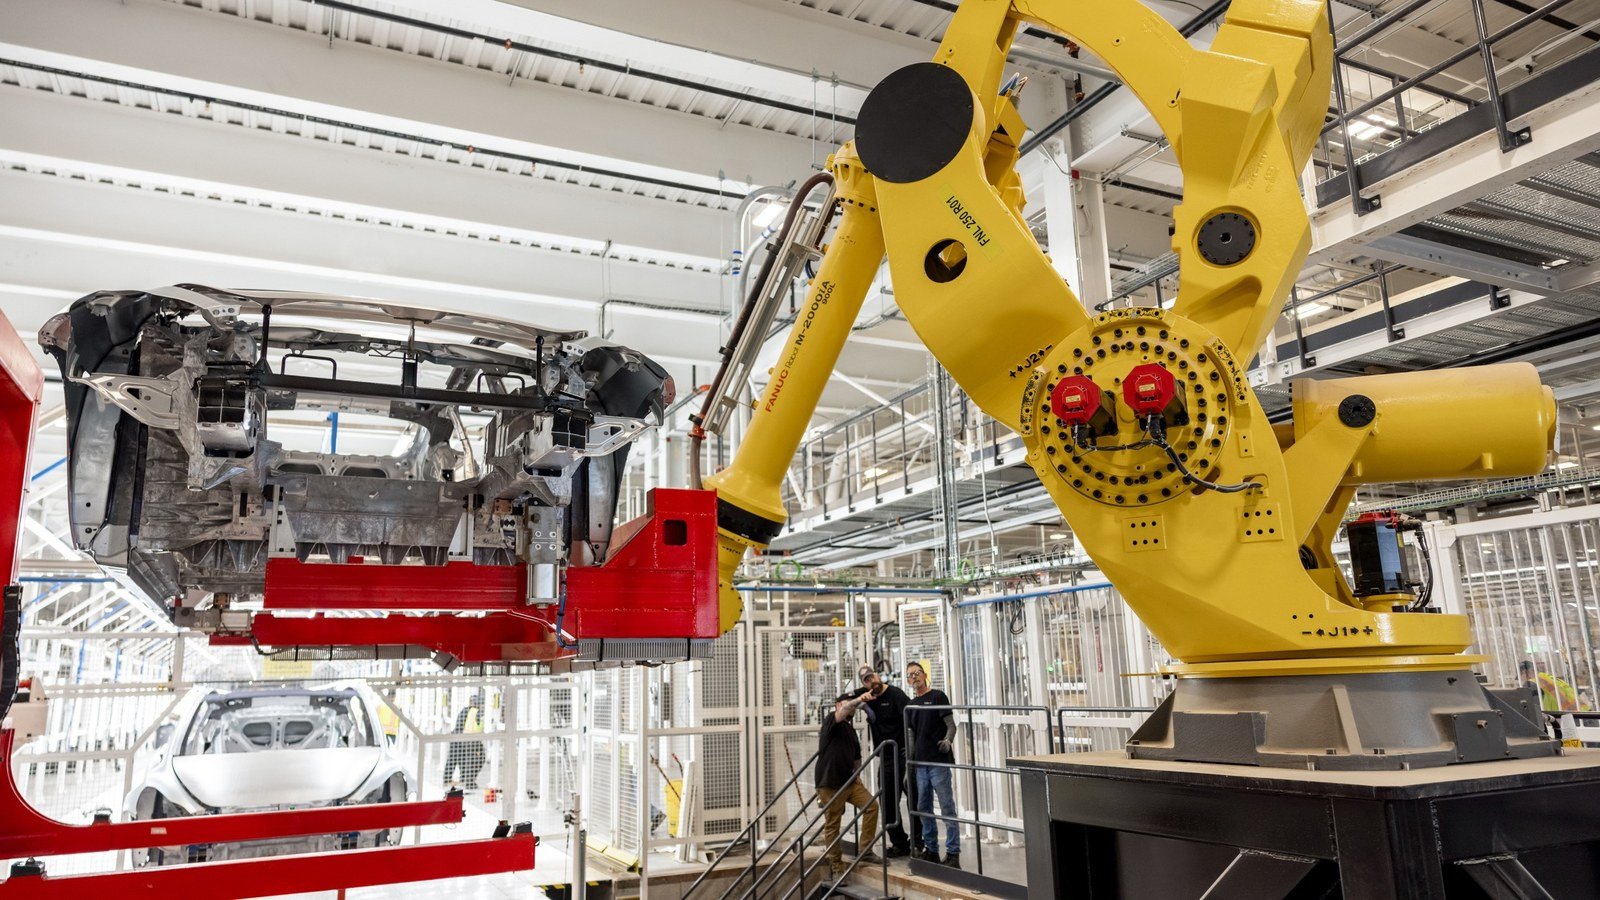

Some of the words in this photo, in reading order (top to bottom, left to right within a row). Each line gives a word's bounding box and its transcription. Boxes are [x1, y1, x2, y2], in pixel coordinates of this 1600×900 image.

[946, 195, 963, 214] R01
[959, 211, 976, 229] 250
[973, 225, 990, 246] FNL
[821, 283, 836, 305] 900L
[765, 369, 788, 412] FANUC
[785, 347, 799, 368] Robot
[795, 280, 830, 345] M-2000iA
[1024, 353, 1041, 369] J2
[1328, 626, 1347, 637] J1
